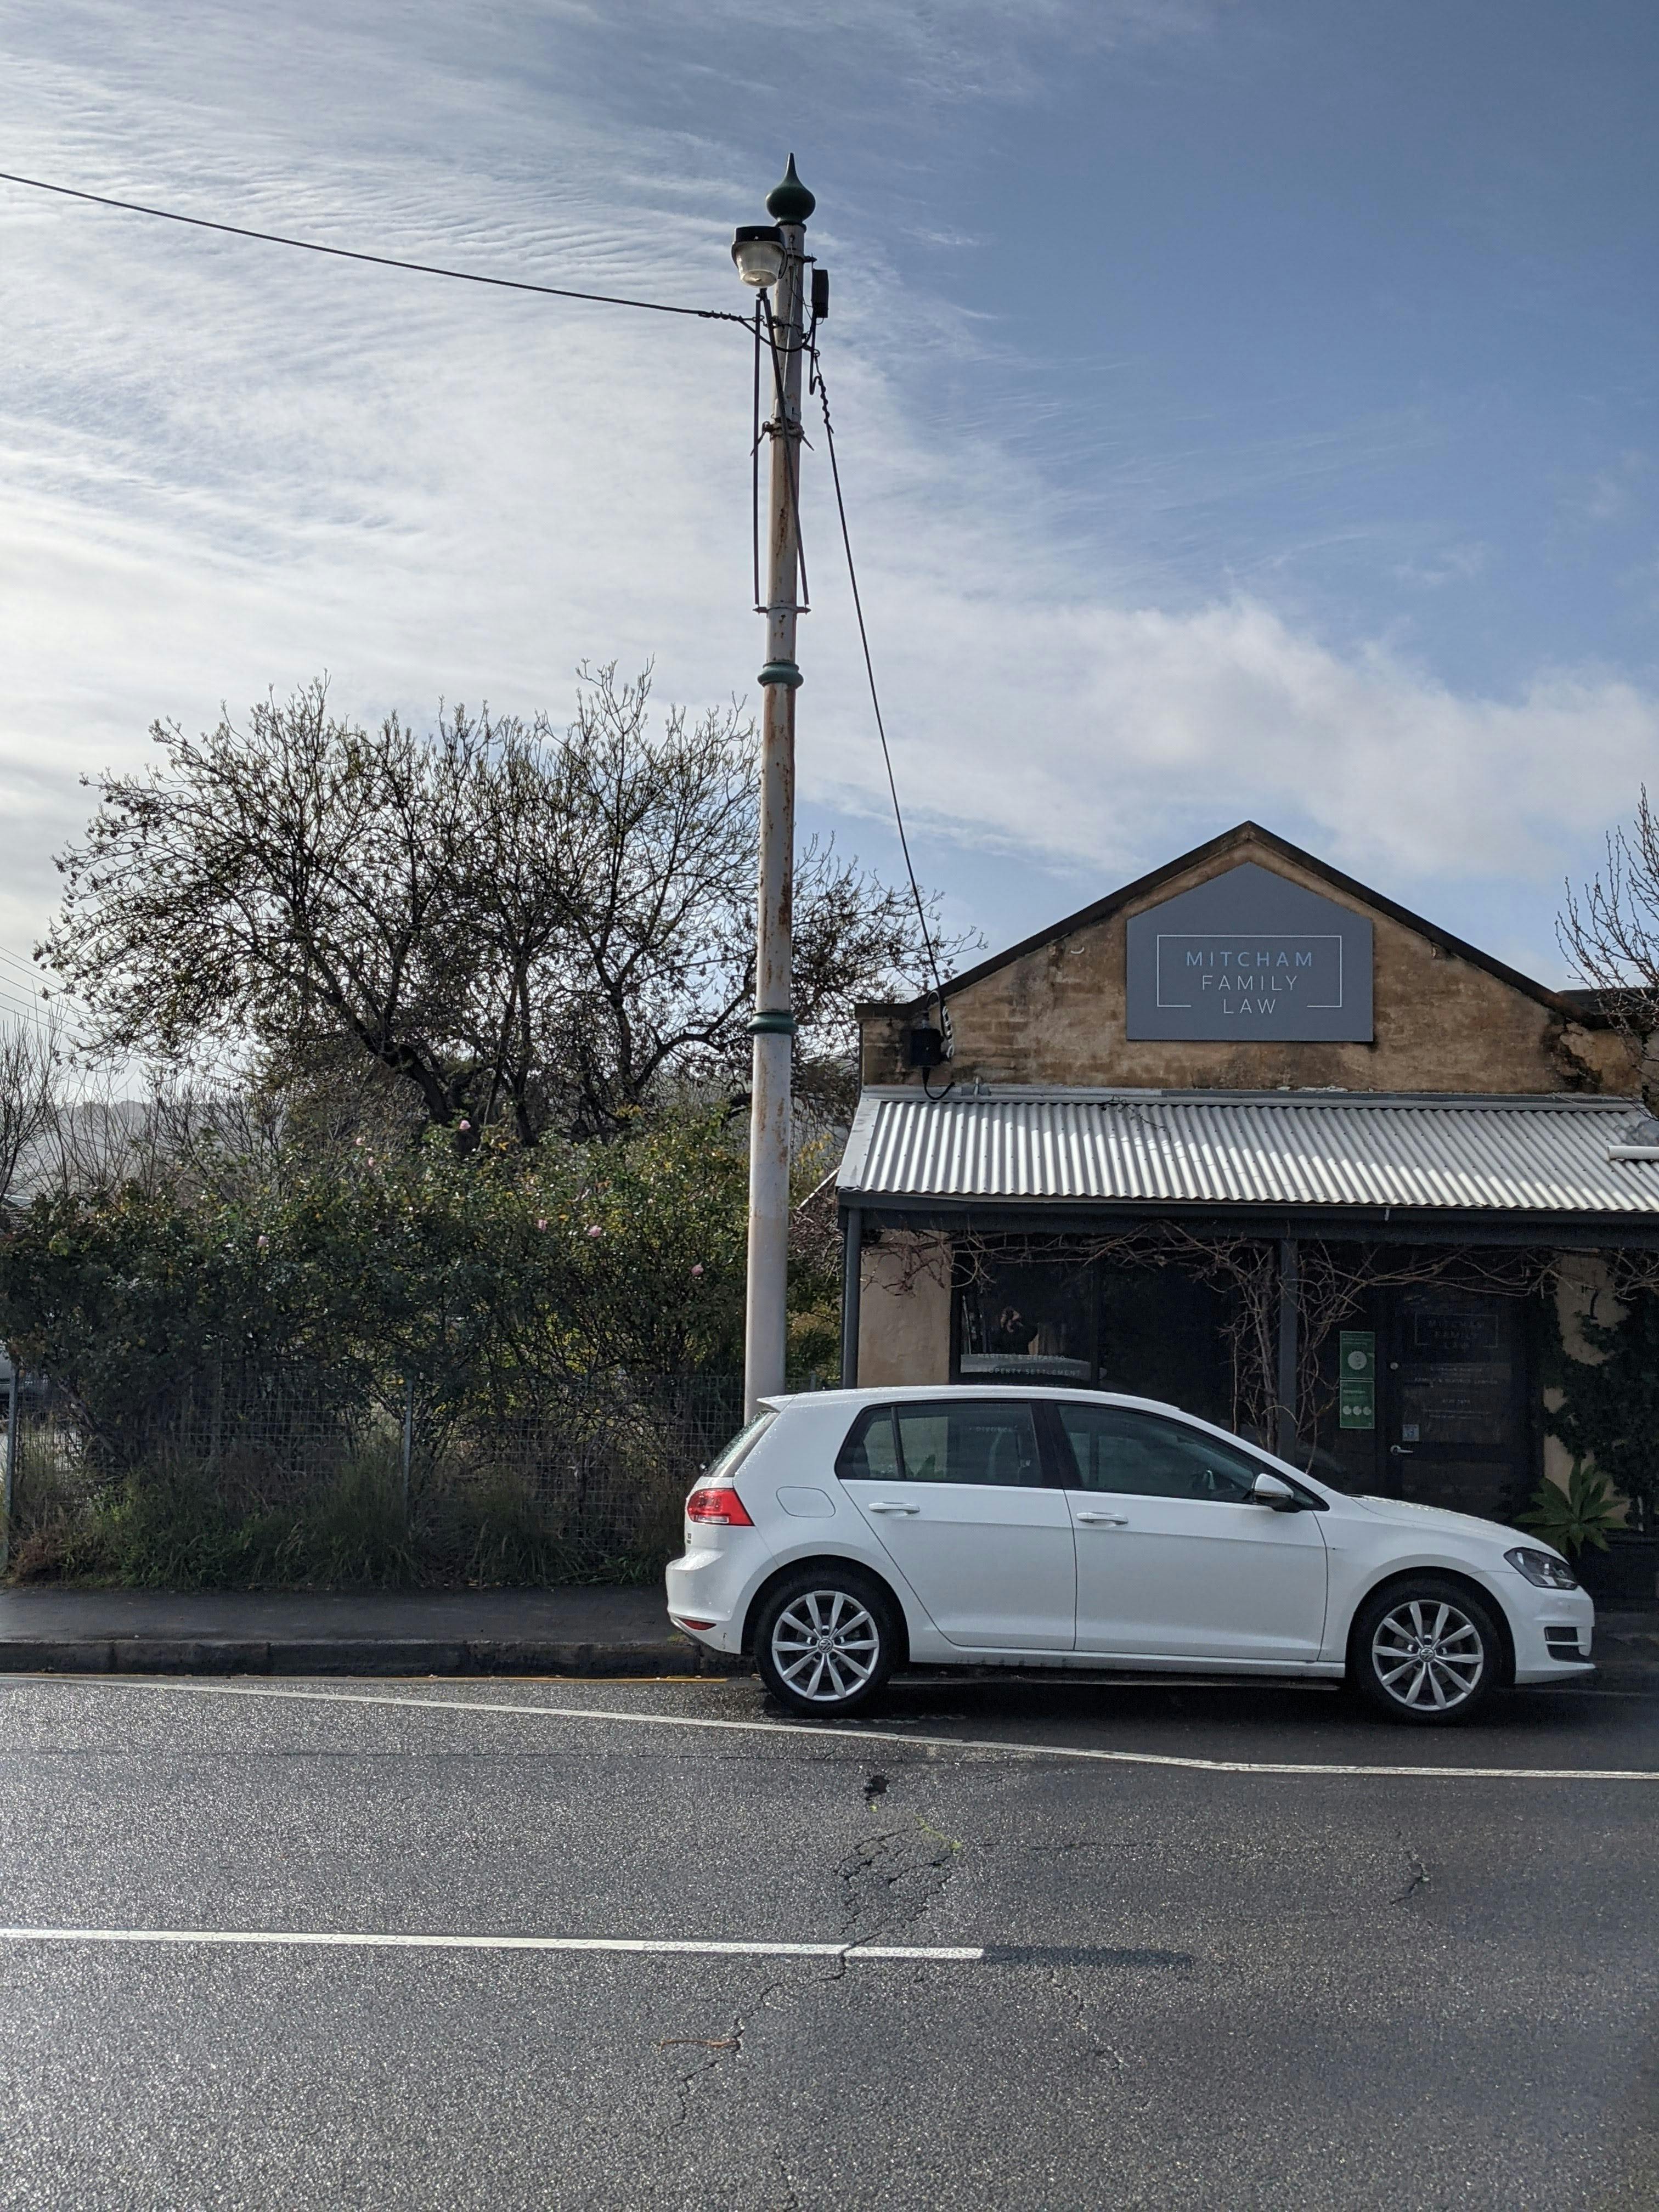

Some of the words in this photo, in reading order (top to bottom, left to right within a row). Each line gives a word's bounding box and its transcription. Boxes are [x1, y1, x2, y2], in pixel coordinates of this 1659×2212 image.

[1186, 951, 1313, 967] MITCHAM
[1202, 975, 1297, 991] FAMILY
[1223, 999, 1277, 1014] LAW
